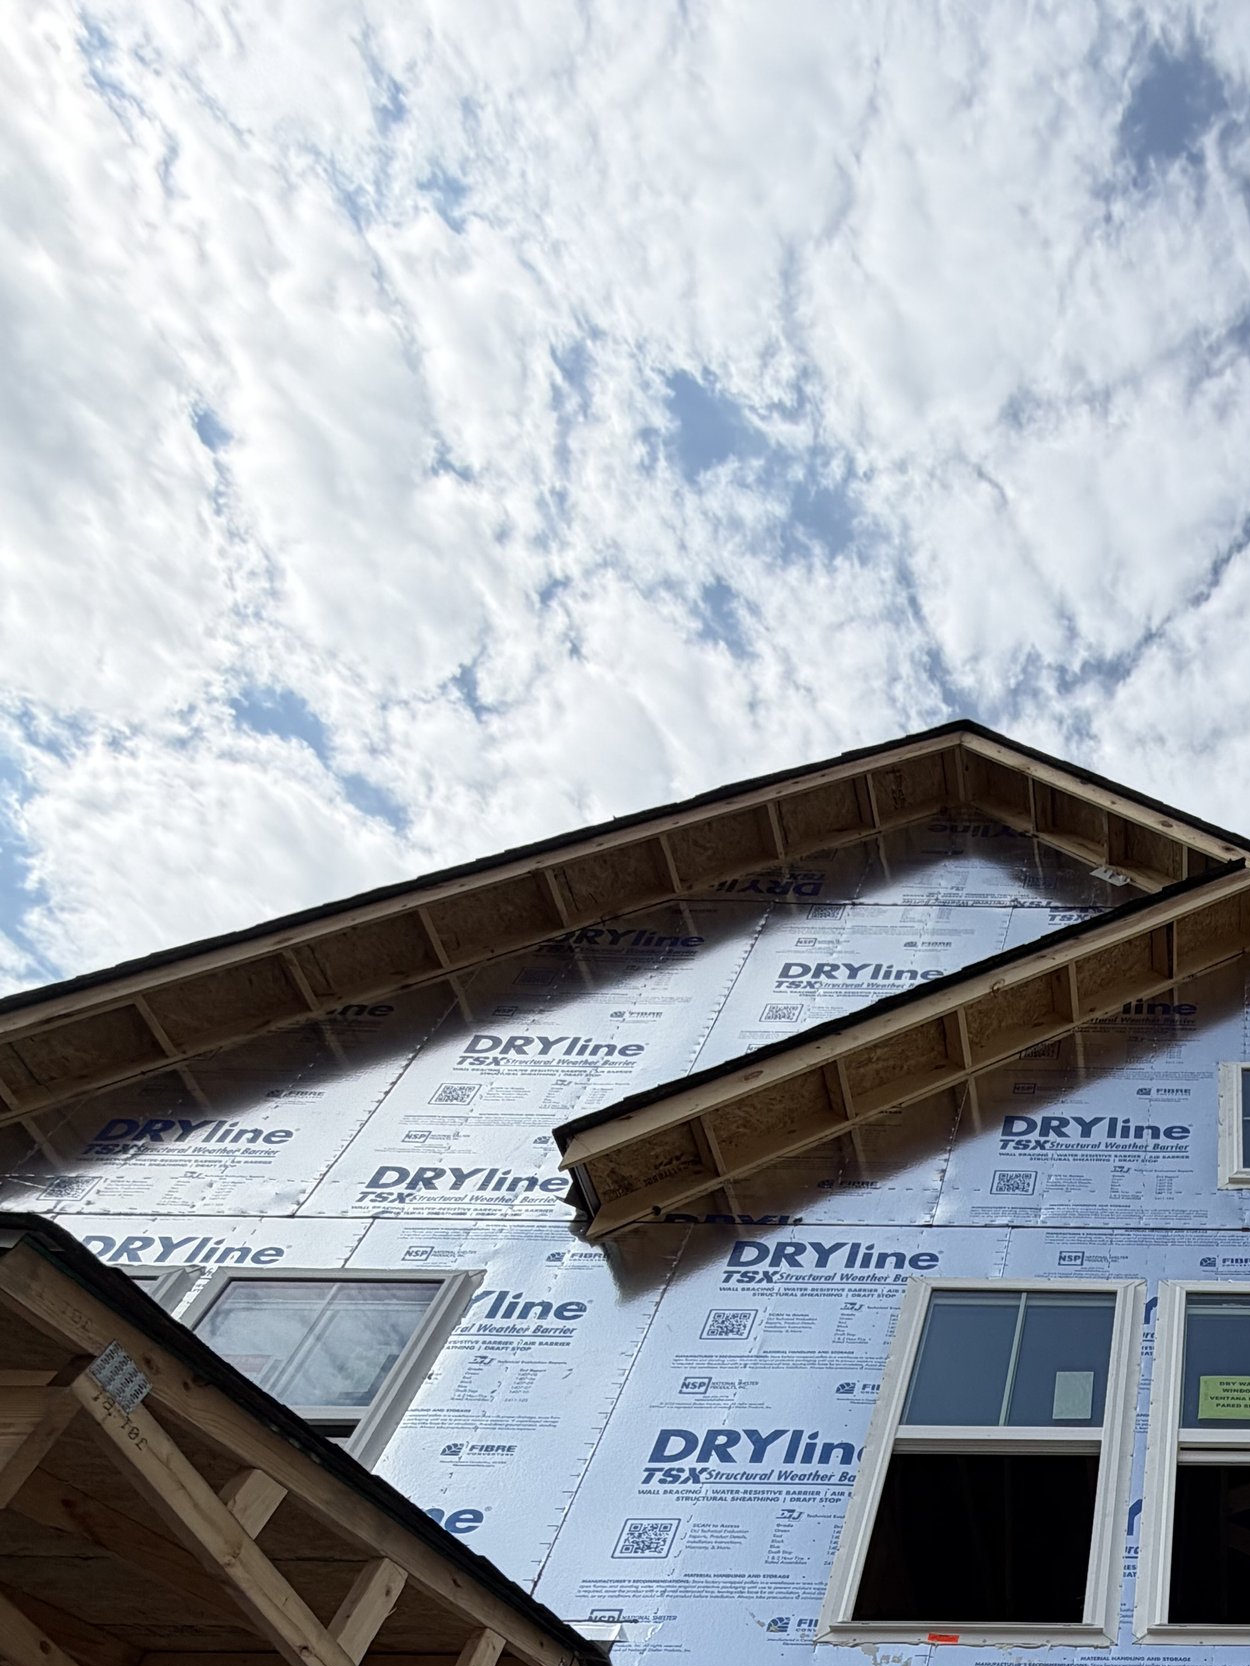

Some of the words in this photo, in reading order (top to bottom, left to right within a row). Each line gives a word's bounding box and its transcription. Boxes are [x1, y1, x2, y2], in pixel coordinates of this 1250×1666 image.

[778, 962, 944, 980] DRYline
[774, 981, 819, 989] TSX
[464, 1034, 645, 1057] DRYline
[456, 1056, 506, 1066] TSX
[92, 1119, 294, 1144] DRYline
[1001, 1116, 1191, 1140] DRYline
[1000, 1139, 1050, 1150] TSX
[365, 1165, 570, 1192] DRYline
[358, 1192, 413, 1203] TSX
[80, 1236, 284, 1264] DRYline
[726, 1241, 939, 1270] DRYline
[722, 1271, 781, 1284] TSX
[776, 1272, 836, 1282] Structural
[469, 1444, 517, 1453] FIBRE
[646, 1428, 864, 1466] DRYlin
[641, 1467, 707, 1485] TSX
[705, 1467, 773, 1484] Structural
[776, 1469, 836, 1485] Weather
